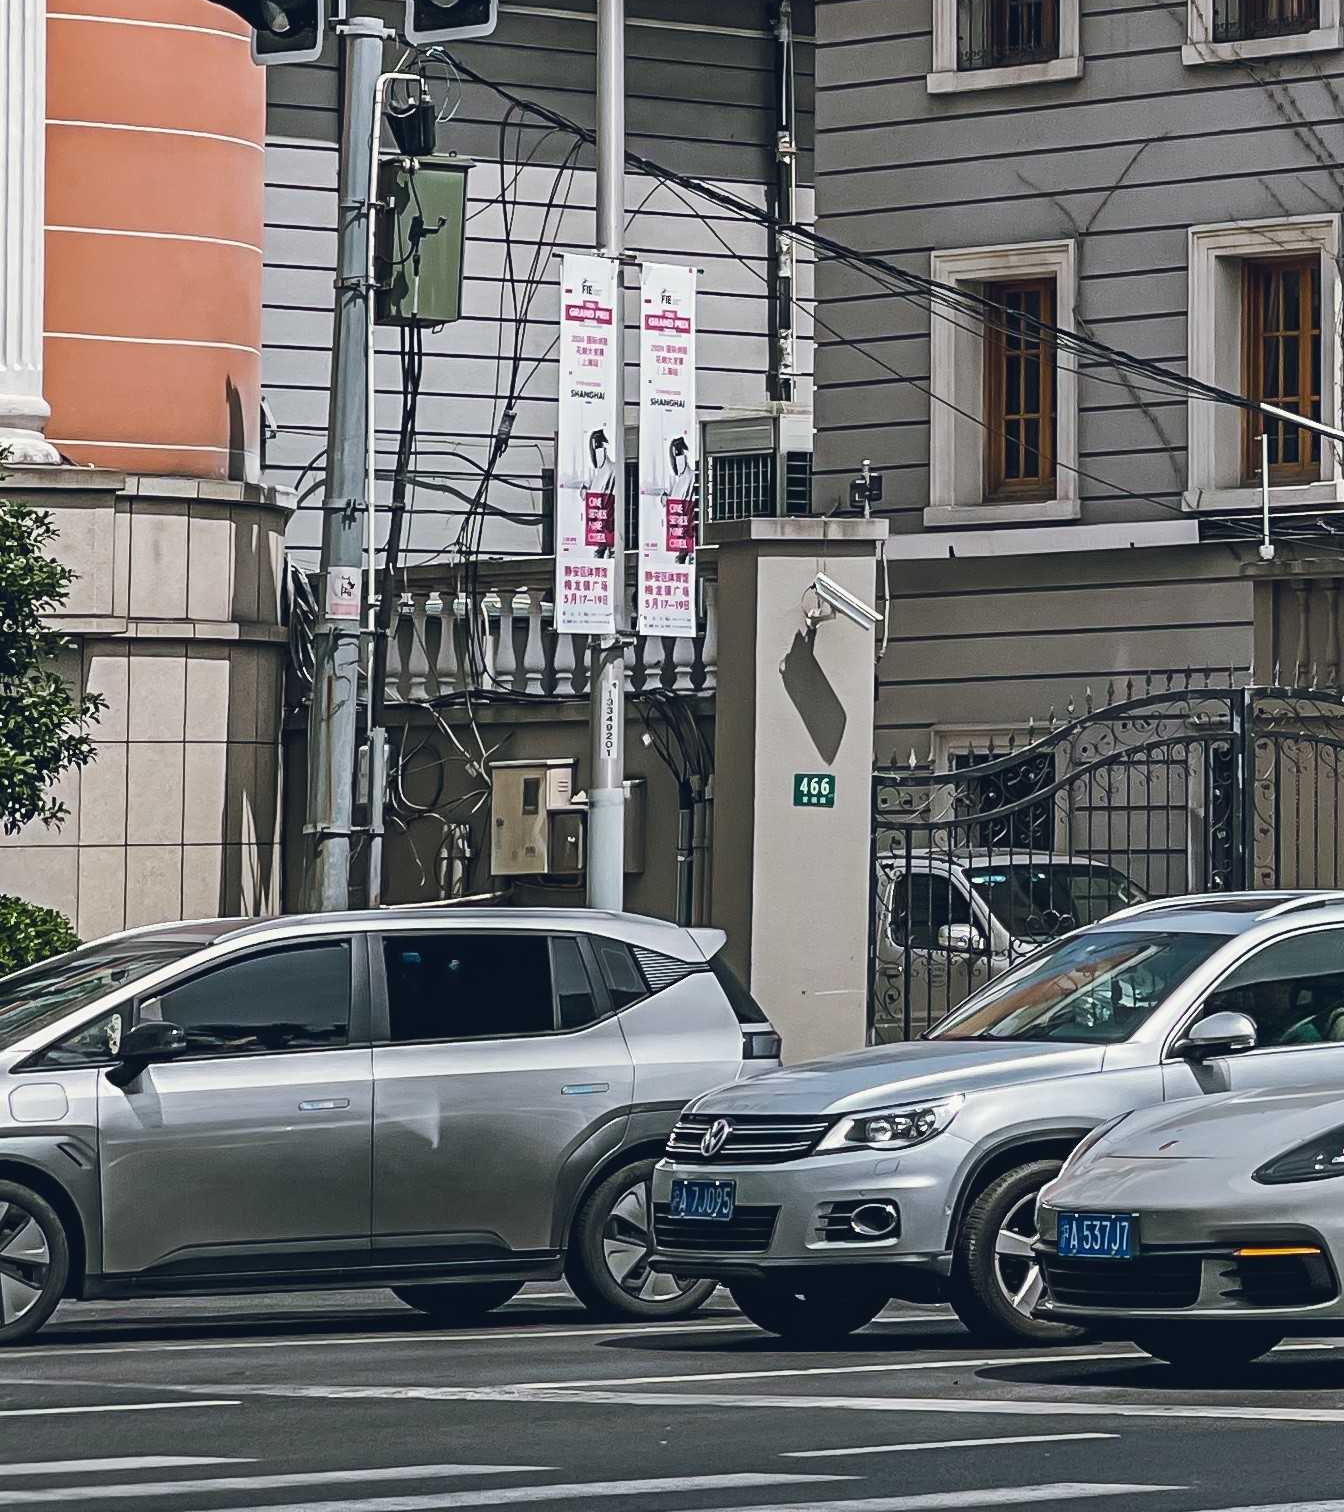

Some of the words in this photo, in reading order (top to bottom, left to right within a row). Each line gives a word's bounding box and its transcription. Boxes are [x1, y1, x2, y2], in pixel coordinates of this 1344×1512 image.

[570, 389, 606, 401] SHANGHAI
[650, 397, 686, 409] SHANGHAI
[564, 565, 608, 578] 静安区体育馆
[644, 571, 690, 584] 静安区体育馆
[564, 580, 608, 592] 梅龙镇广场
[644, 585, 690, 597] 梅龙镇广场
[799, 777, 830, 795] 466
